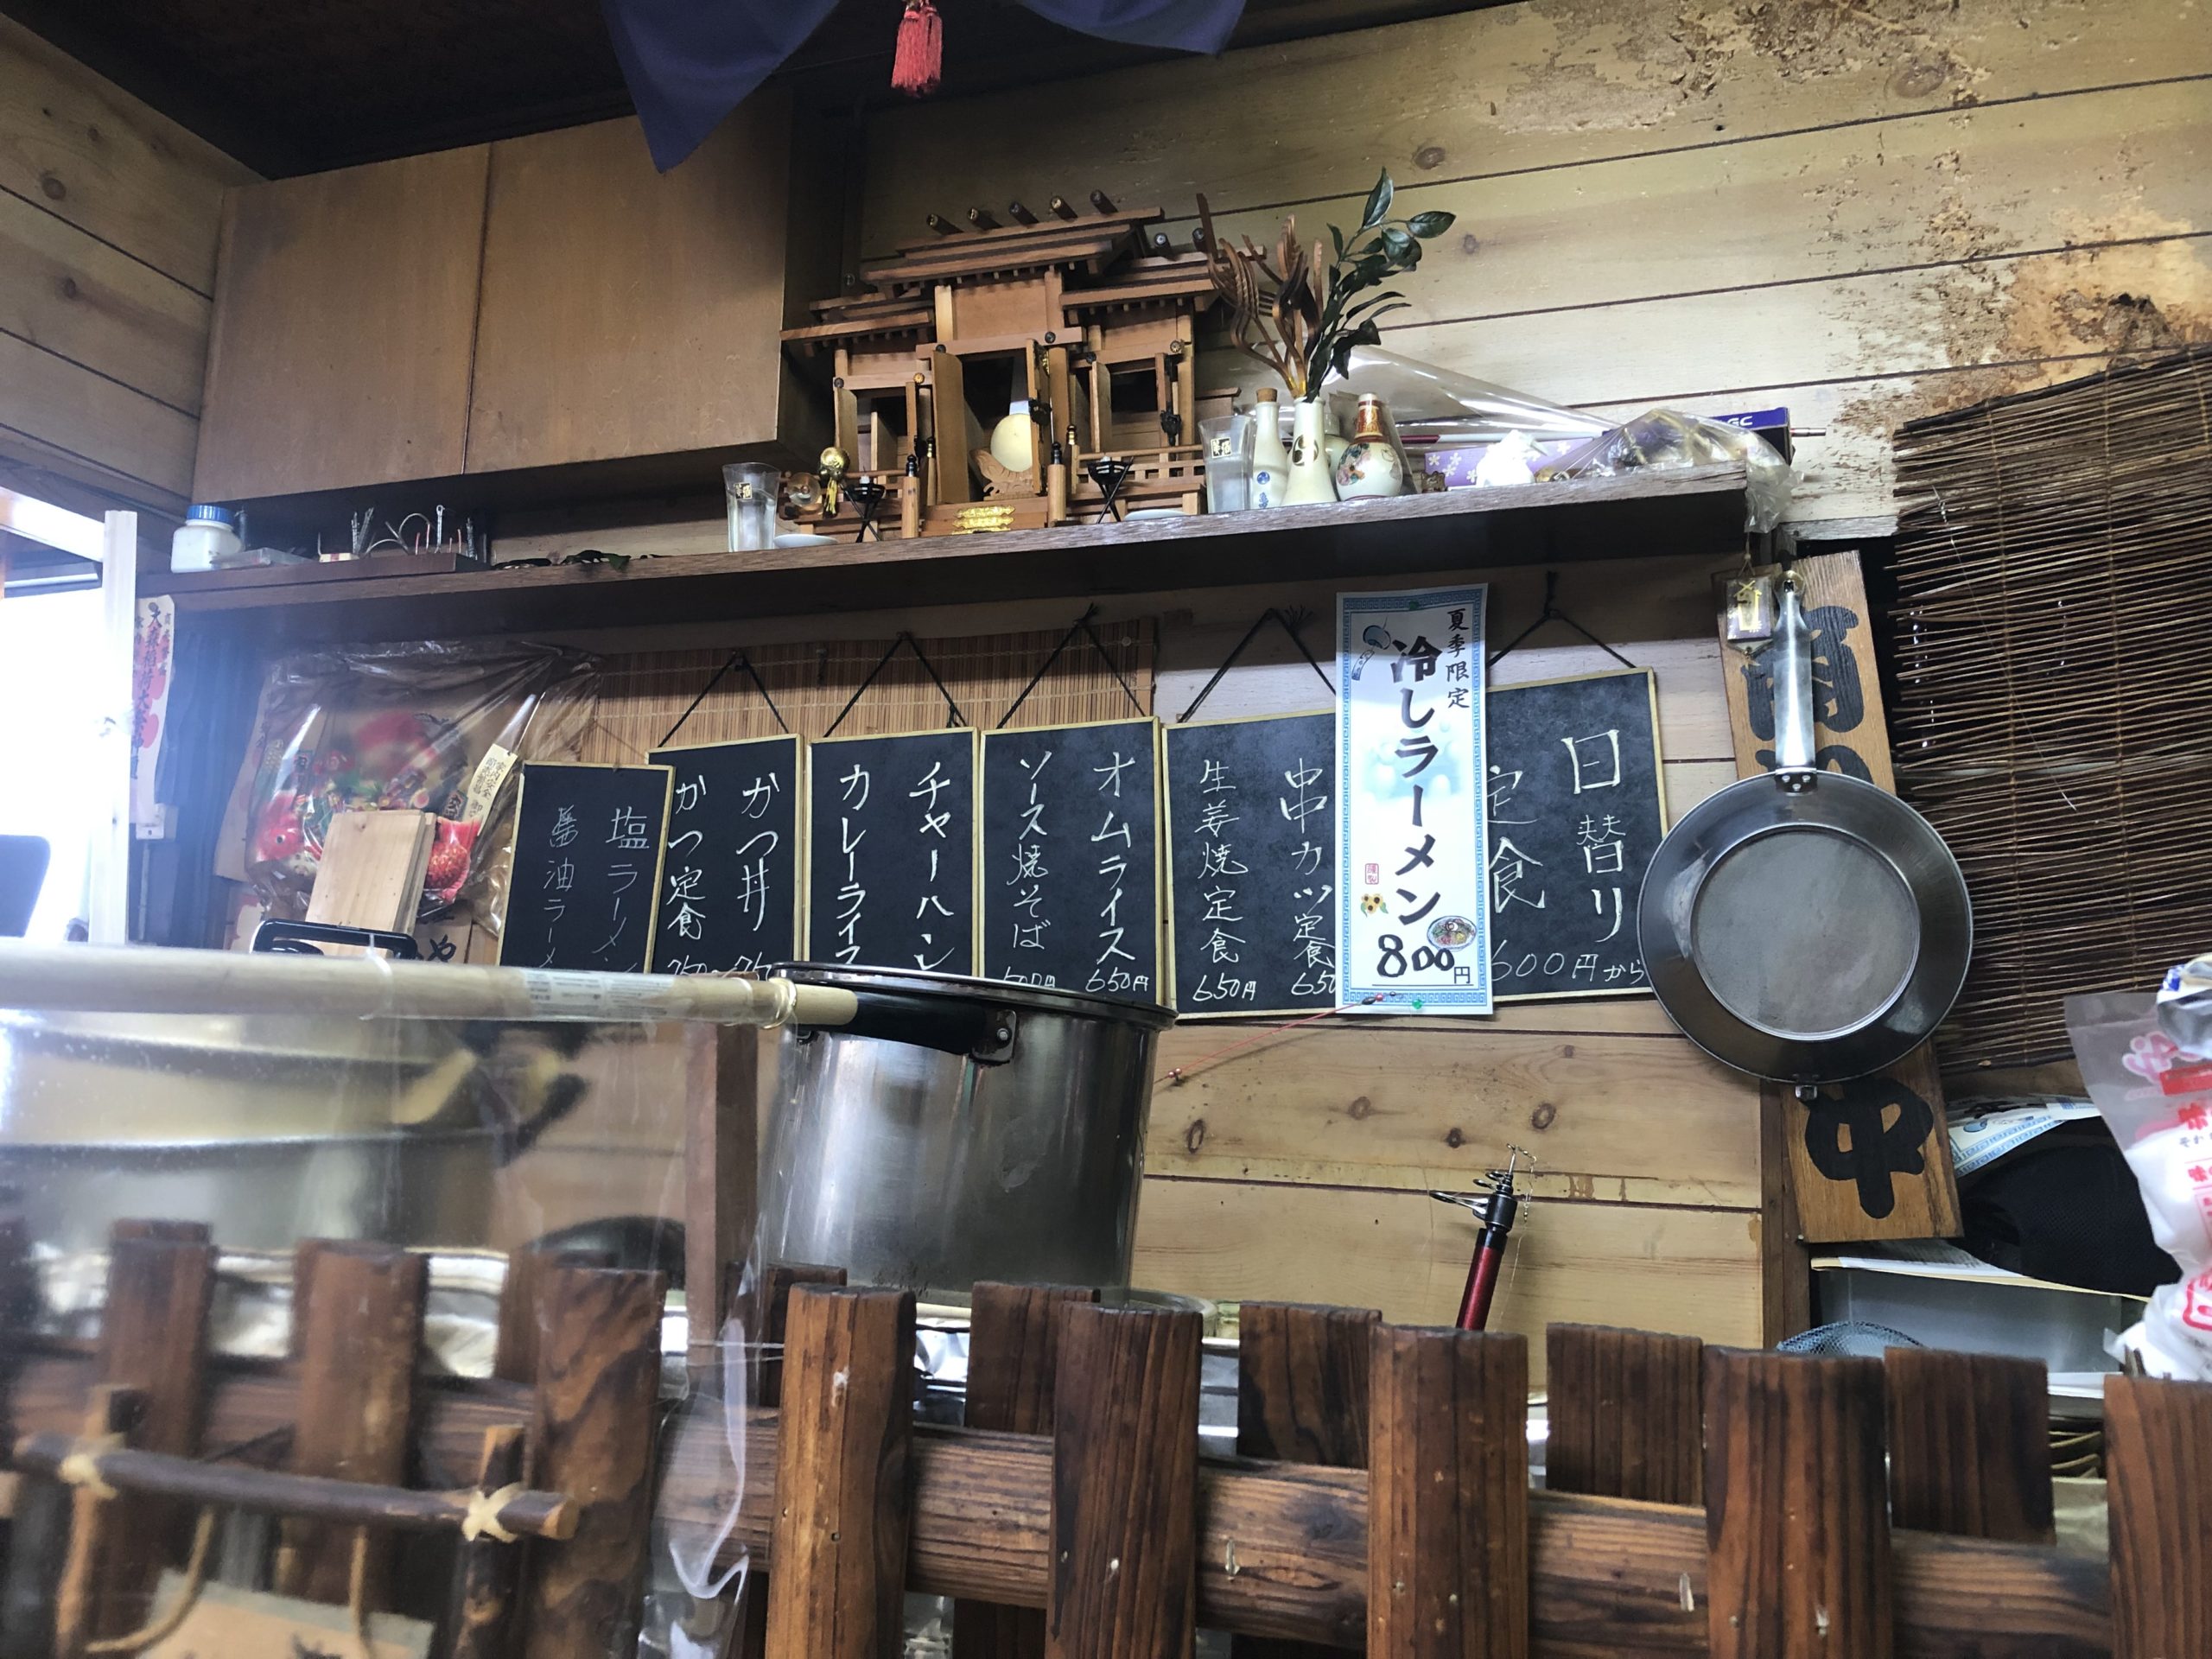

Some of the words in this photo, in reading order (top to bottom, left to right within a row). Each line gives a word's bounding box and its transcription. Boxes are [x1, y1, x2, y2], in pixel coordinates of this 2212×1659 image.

[1445, 607, 1470, 709] 夏季限定
[667, 774, 707, 940] かつ定食
[736, 772, 780, 932] かつ丼
[909, 761, 956, 970] チャーハン
[1006, 751, 1052, 950] ソース焼そば
[1091, 752, 1136, 964] オムライス
[1195, 760, 1249, 963] 生姜焼定食
[1280, 758, 1336, 969] 串カツ定食
[1391, 634, 1443, 926] 冷しラーメン
[1561, 729, 1627, 944] 日替り
[1085, 967, 1149, 992] 650円
[1192, 973, 1257, 1001] 650円
[1376, 933, 1471, 984] 800円
